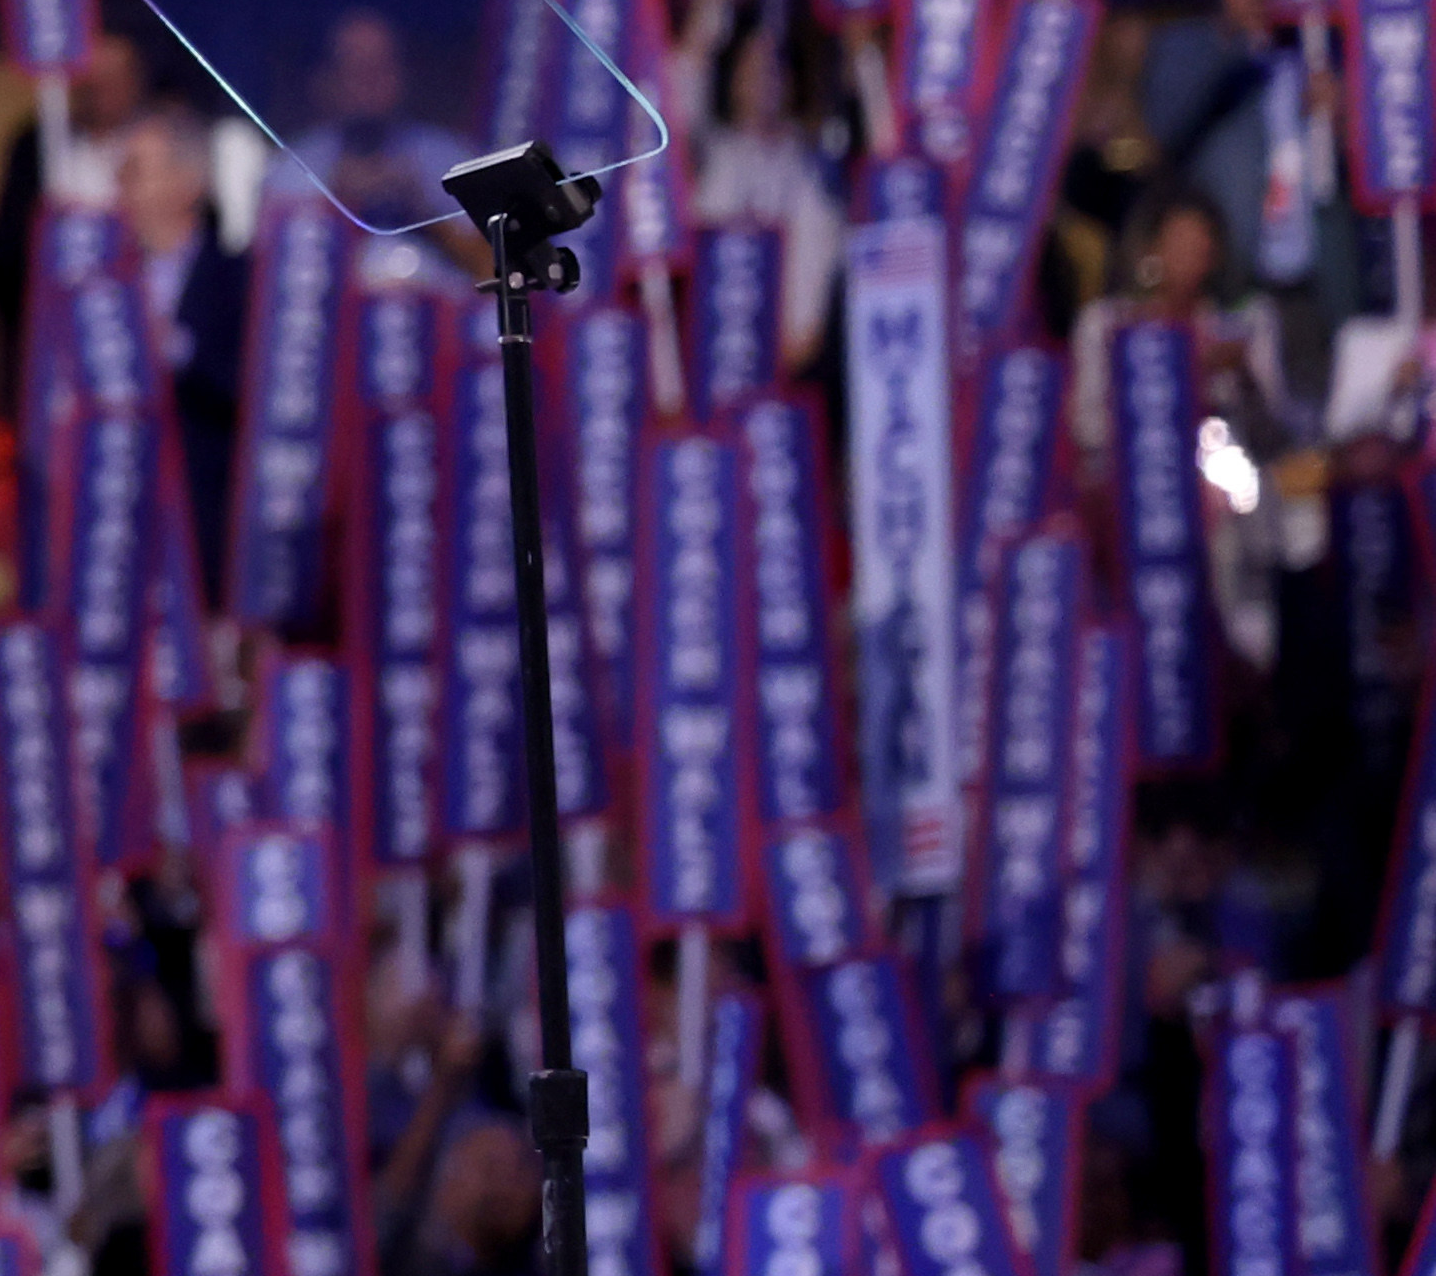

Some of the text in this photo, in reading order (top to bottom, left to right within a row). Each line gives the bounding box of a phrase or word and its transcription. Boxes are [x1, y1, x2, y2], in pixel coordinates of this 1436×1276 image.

[659, 436, 733, 915] COACH WALZ
[269, 948, 333, 1209] COACH
